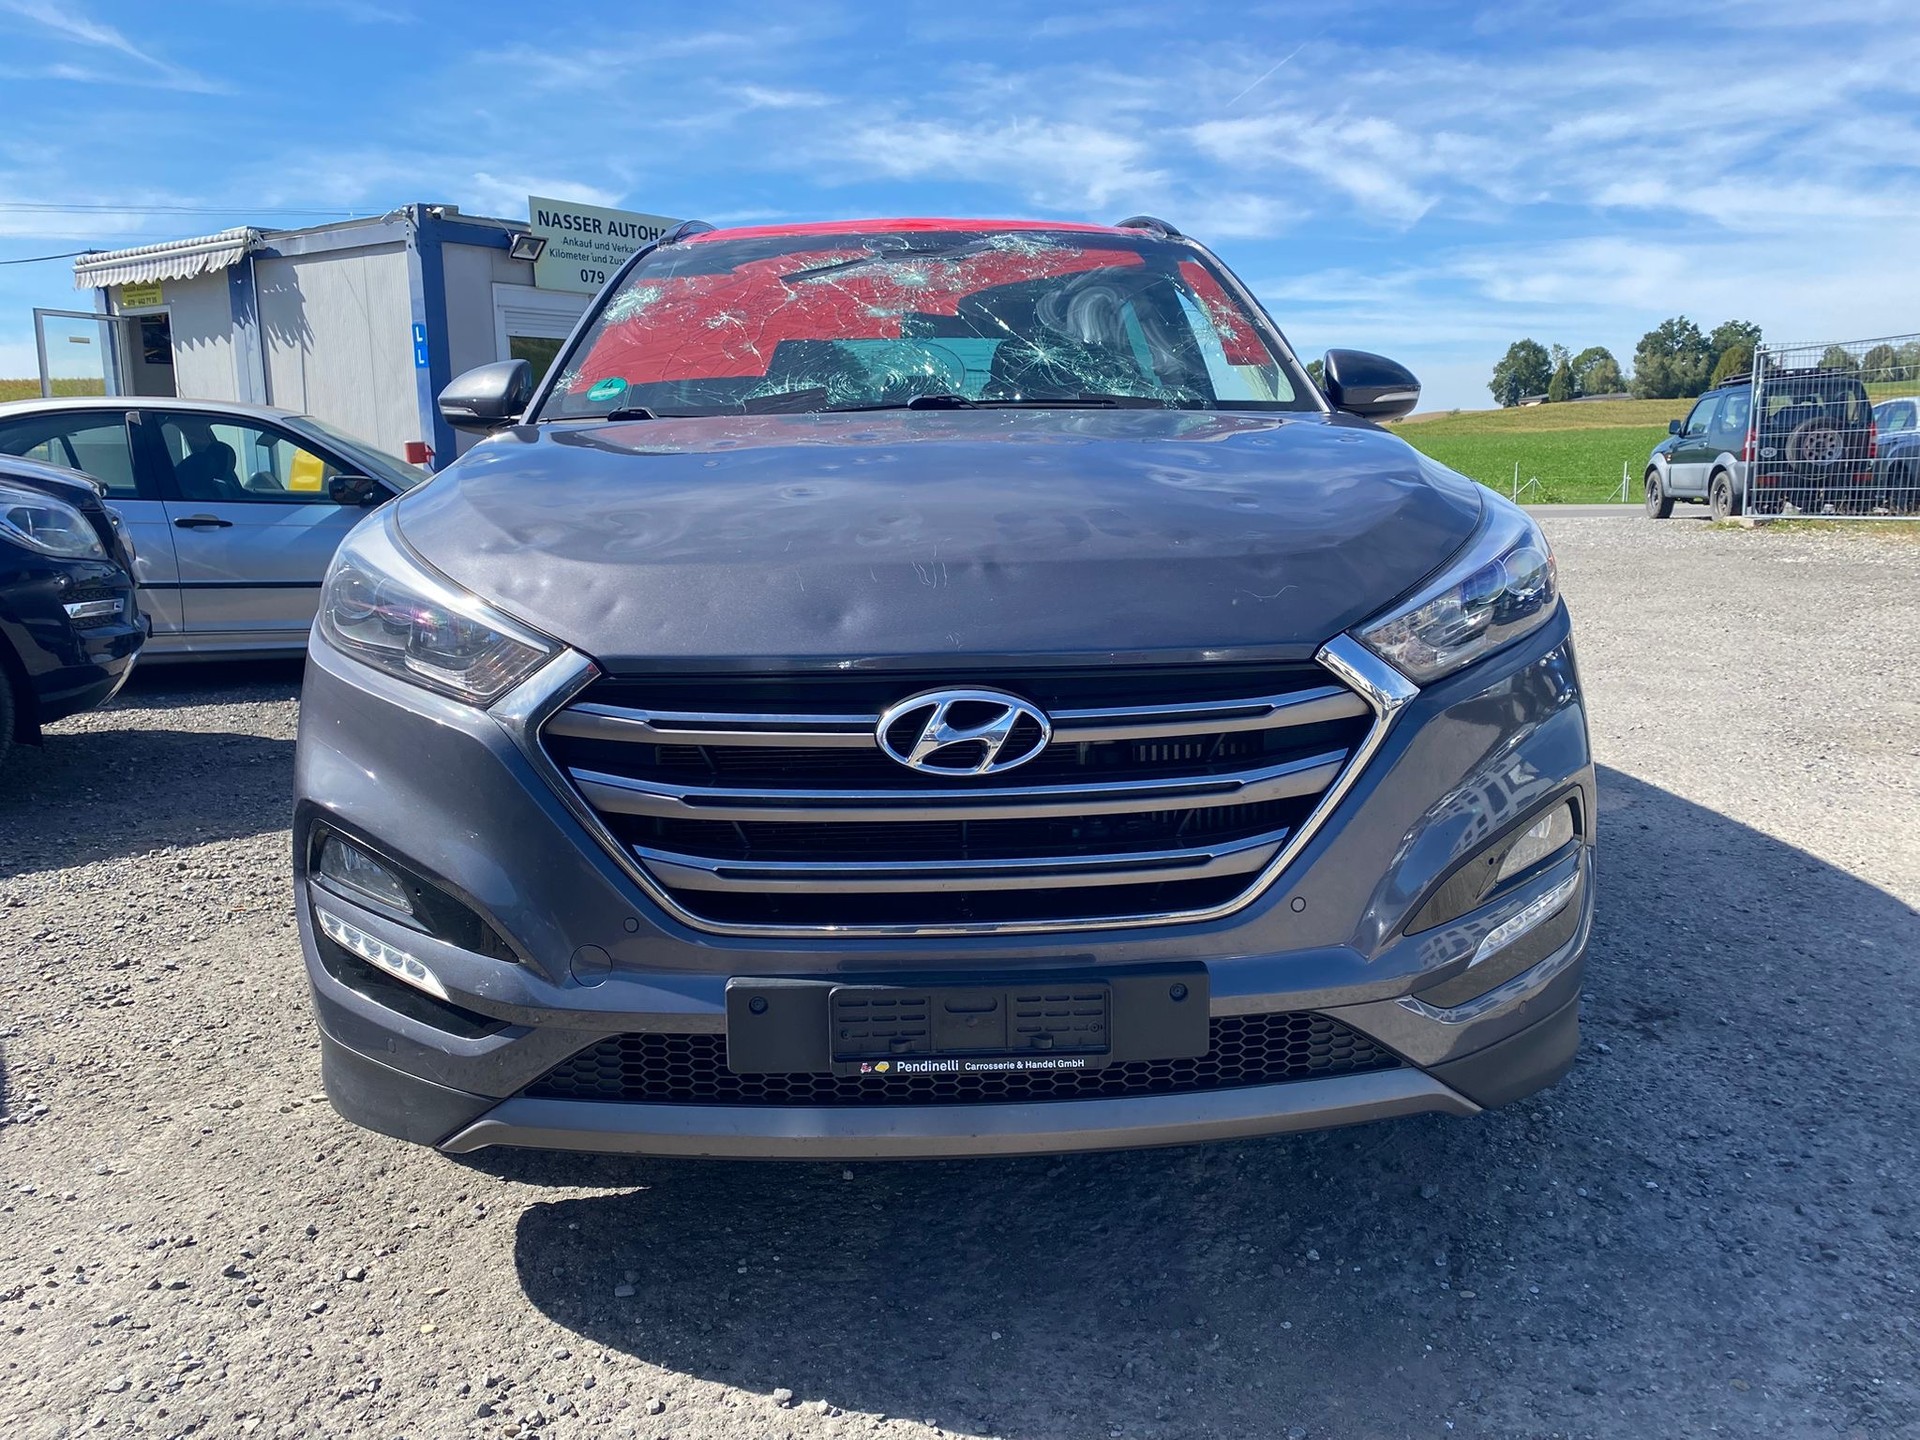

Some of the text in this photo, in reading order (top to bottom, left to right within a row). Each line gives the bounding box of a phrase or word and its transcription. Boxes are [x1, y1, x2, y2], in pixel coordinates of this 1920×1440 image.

[538, 210, 602, 234] NASSER
[562, 237, 592, 249] Ankauf
[594, 241, 610, 251] und
[550, 249, 589, 261] Kilometer
[592, 254, 607, 264] und
[580, 269, 605, 284] 079
[416, 326, 423, 341] L
[418, 349, 424, 363] L
[602, 379, 614, 389] 4
[897, 1059, 1085, 1072] Pendinelli Carrosserie & Handel GmbH
